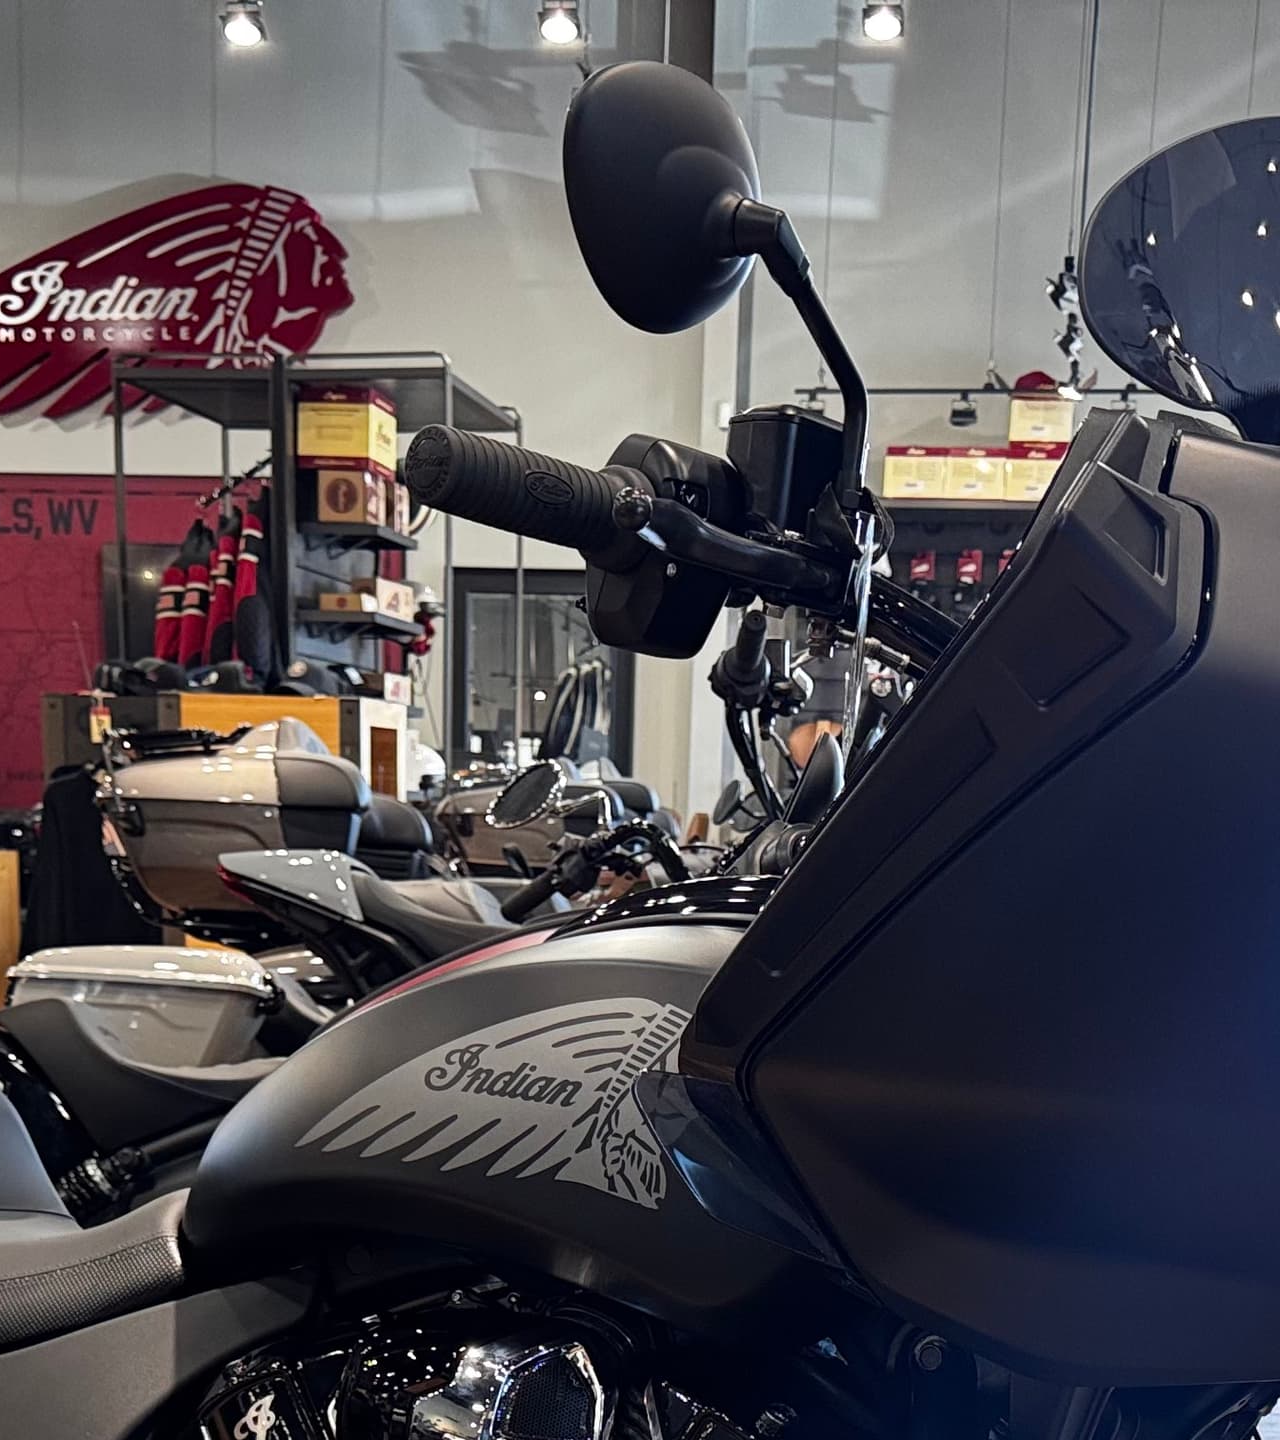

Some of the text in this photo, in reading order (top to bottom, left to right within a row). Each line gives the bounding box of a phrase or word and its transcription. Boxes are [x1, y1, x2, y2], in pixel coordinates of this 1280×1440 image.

[0, 326, 191, 343] MOTORCYCLE
[47, 498, 99, 535] WV
[424, 1043, 583, 1108] Indian
